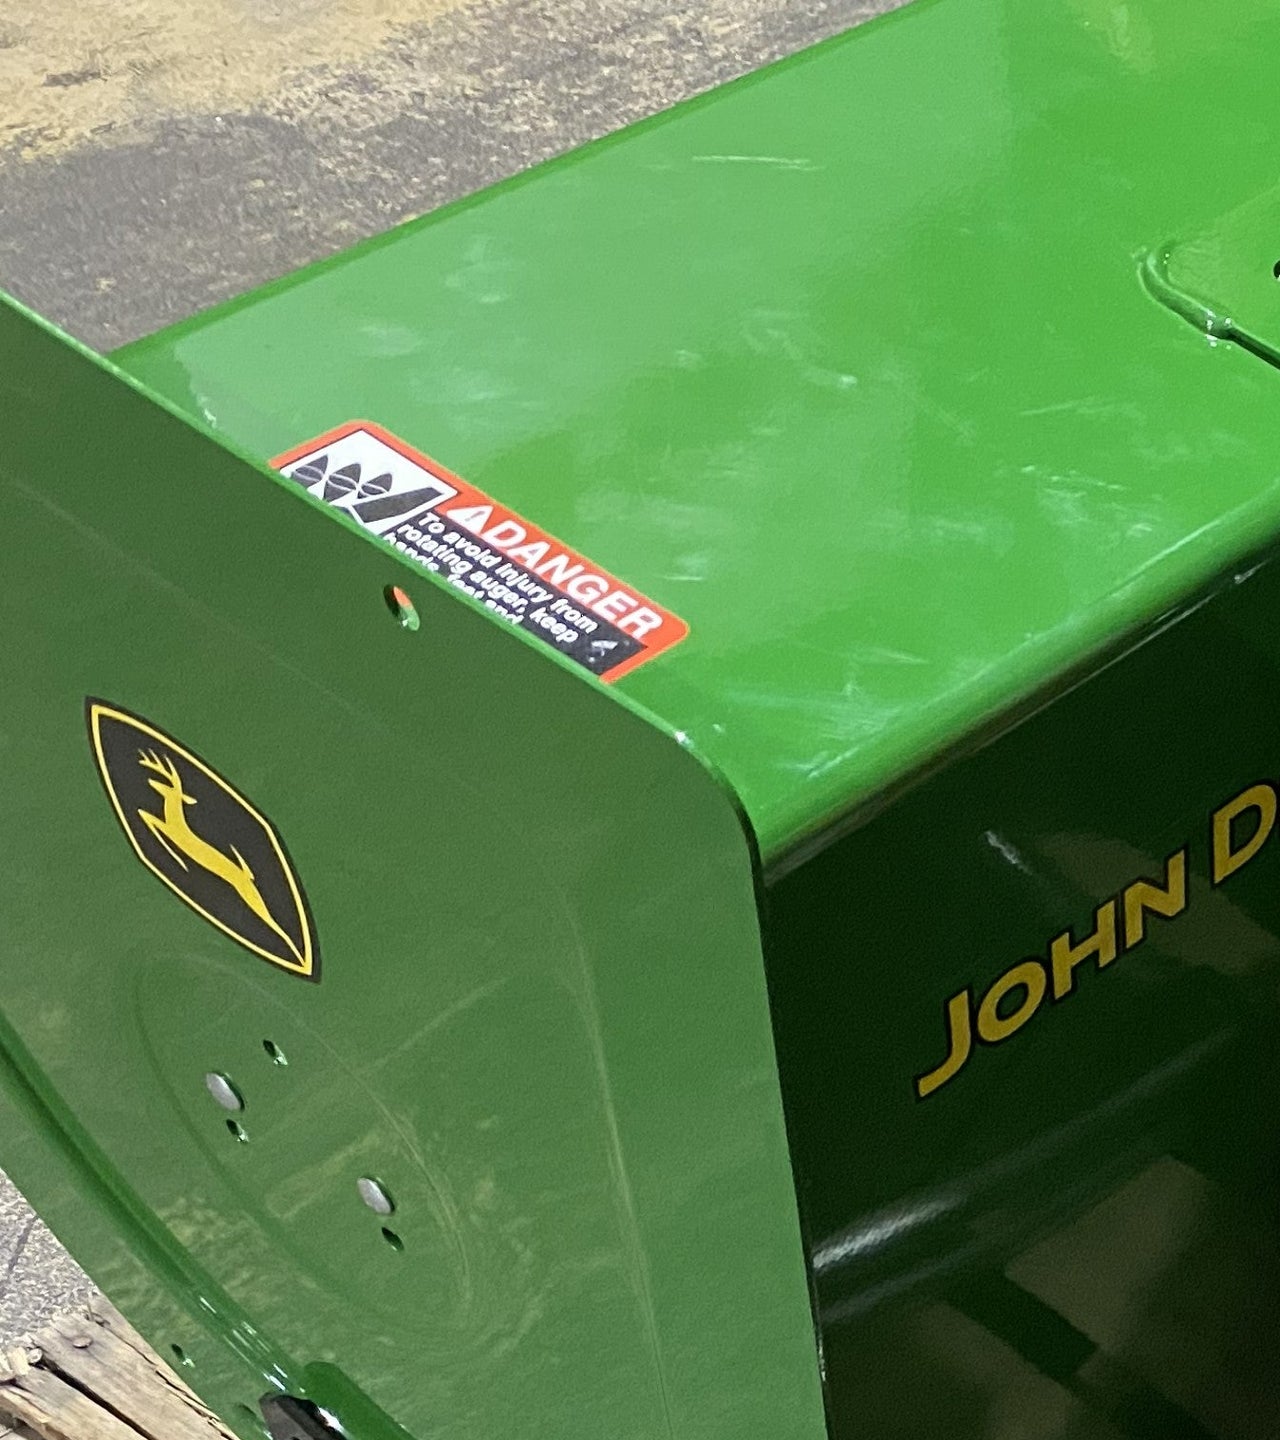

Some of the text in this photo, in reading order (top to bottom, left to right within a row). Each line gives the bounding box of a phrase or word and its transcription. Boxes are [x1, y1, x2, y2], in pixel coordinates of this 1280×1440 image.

[397, 524, 579, 643] rotating auger, keep
[418, 512, 598, 634] To avoid injury from
[481, 520, 663, 640] DANGER
[917, 848, 1187, 1098] JOHN
